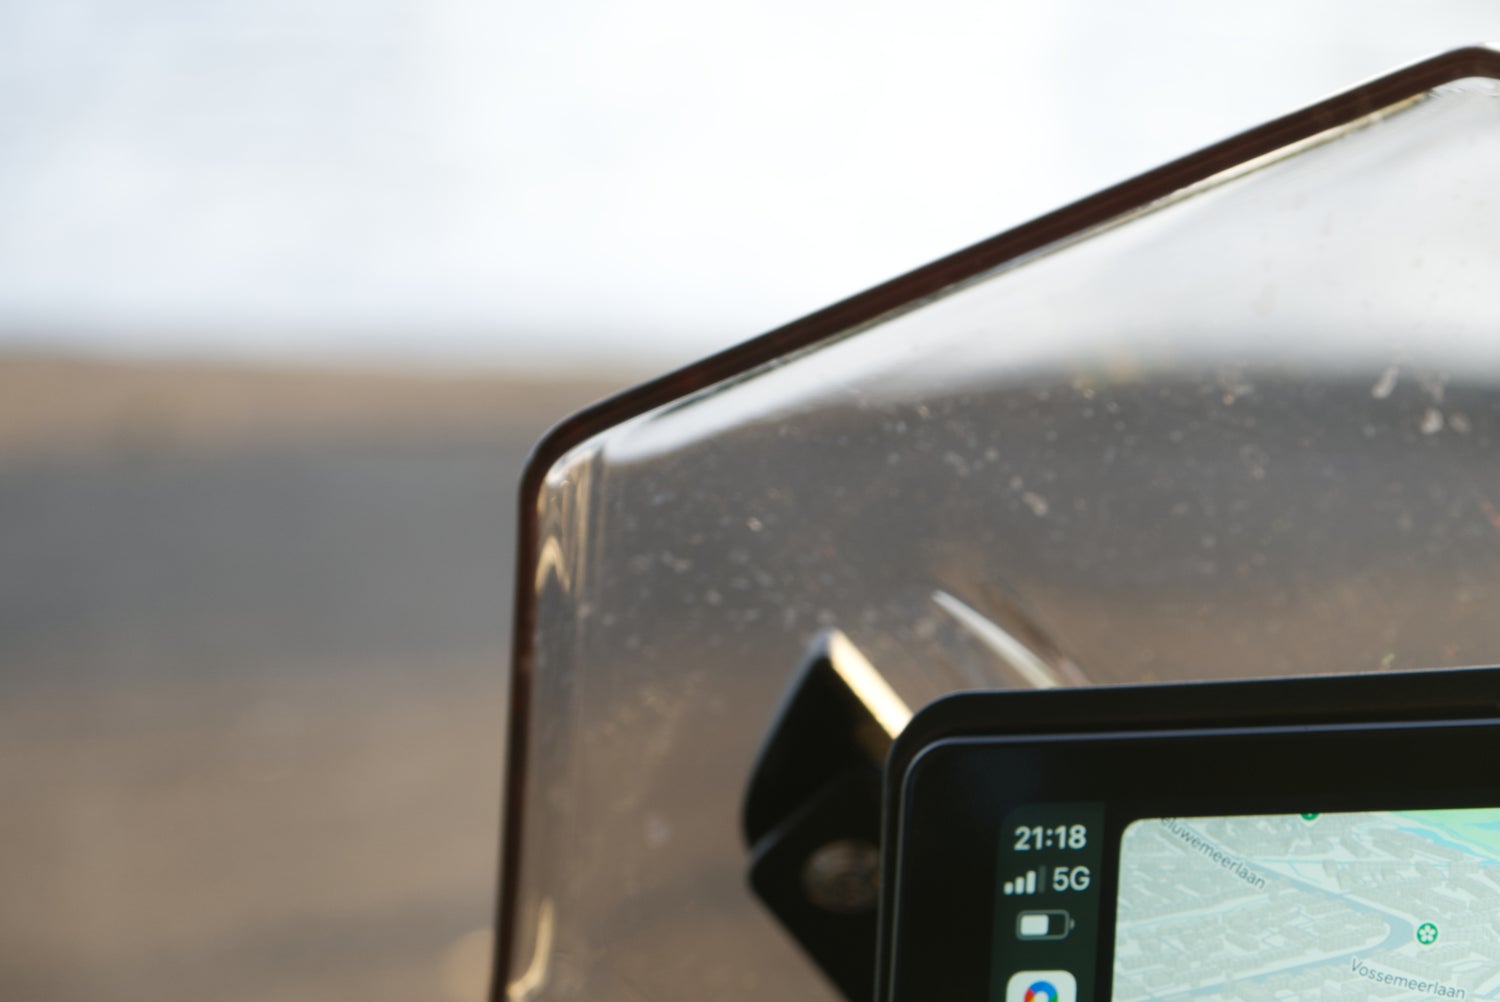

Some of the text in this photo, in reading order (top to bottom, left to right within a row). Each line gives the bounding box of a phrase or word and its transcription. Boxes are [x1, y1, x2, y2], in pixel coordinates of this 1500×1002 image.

[1014, 824, 1087, 851] 21:18
[1053, 865, 1090, 891] 5G
[1351, 958, 1465, 999] Vossemeerlaan
